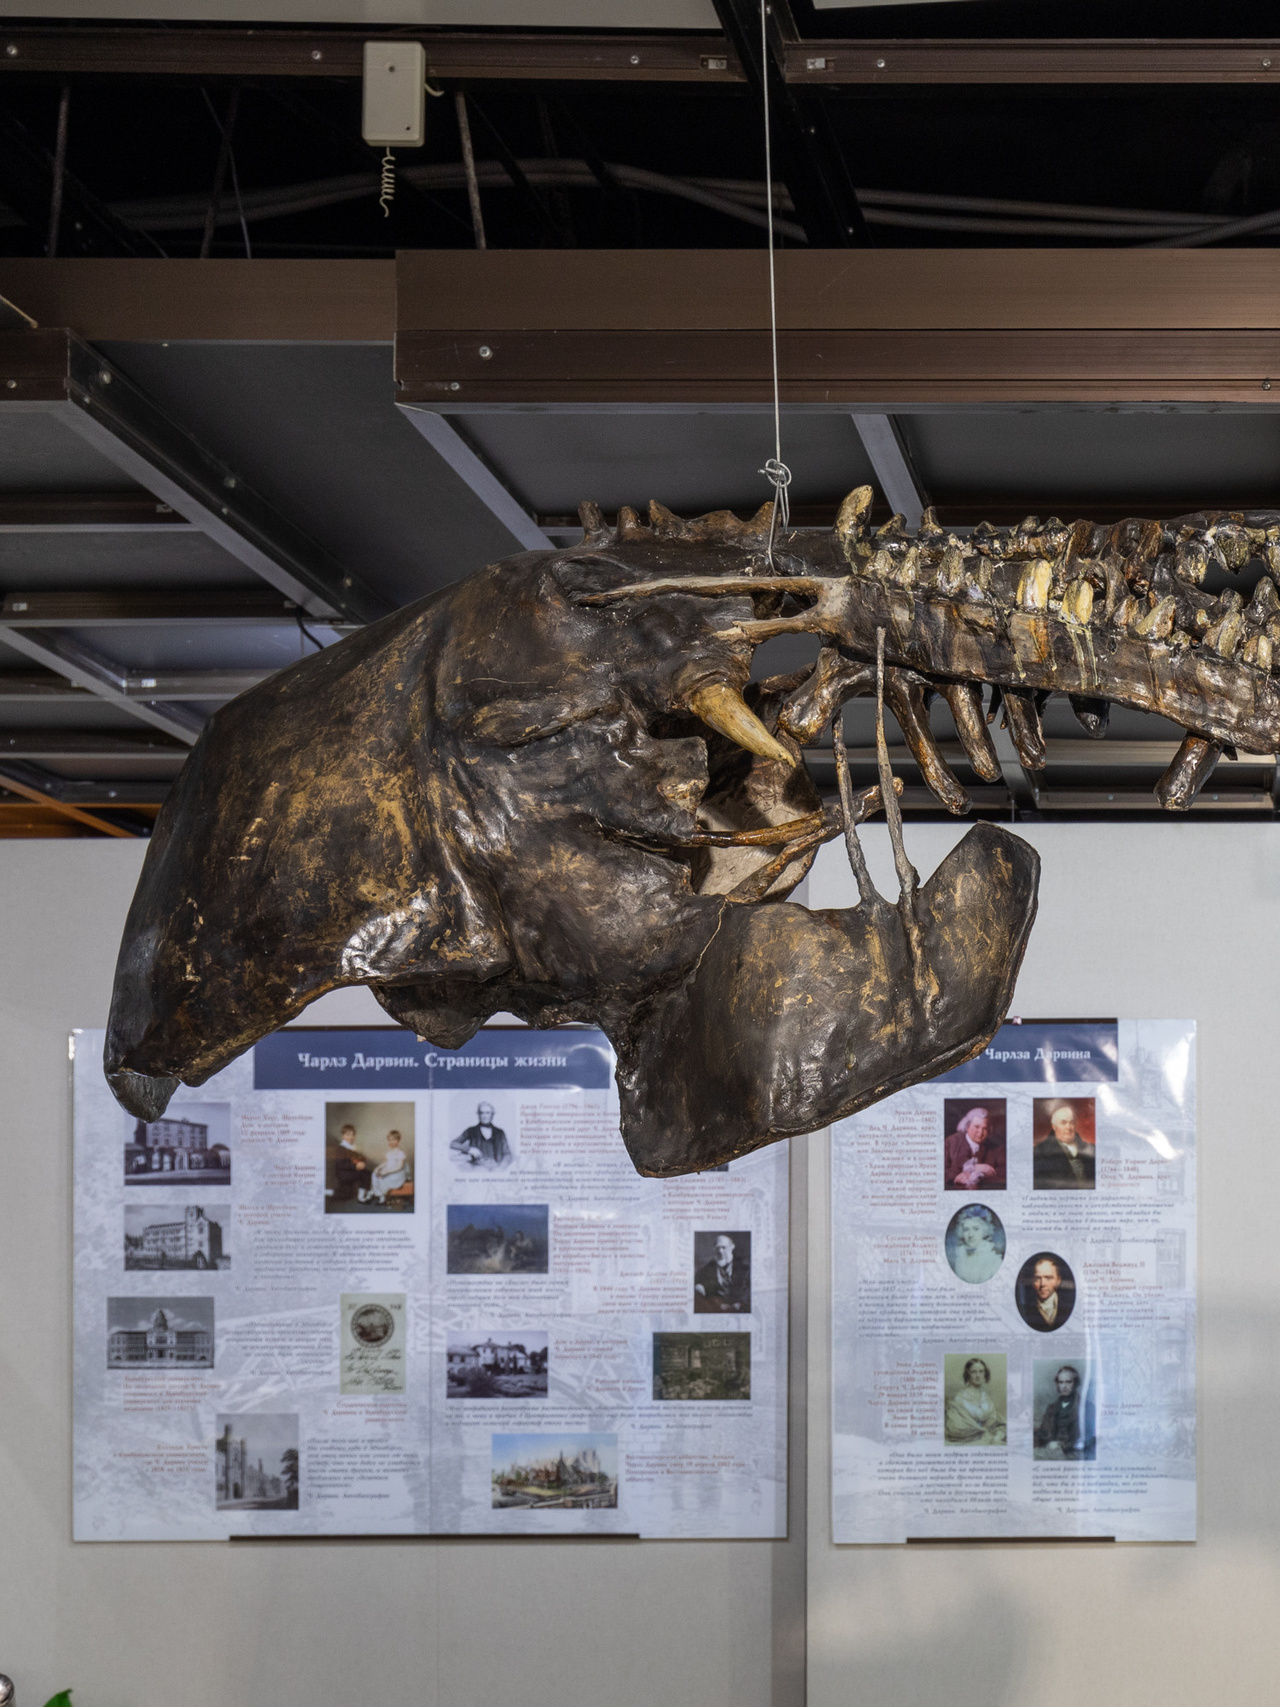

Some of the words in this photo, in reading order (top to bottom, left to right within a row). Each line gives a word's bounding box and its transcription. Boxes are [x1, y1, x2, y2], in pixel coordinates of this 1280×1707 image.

[297, 1052, 348, 1071] Чарлз
[351, 1052, 419, 1071] Дарвин.
[424, 1052, 509, 1071] Страницы
[514, 1056, 567, 1067] жизни
[985, 1047, 1030, 1062] Чарлза
[1034, 1047, 1091, 1062] Дарвина
